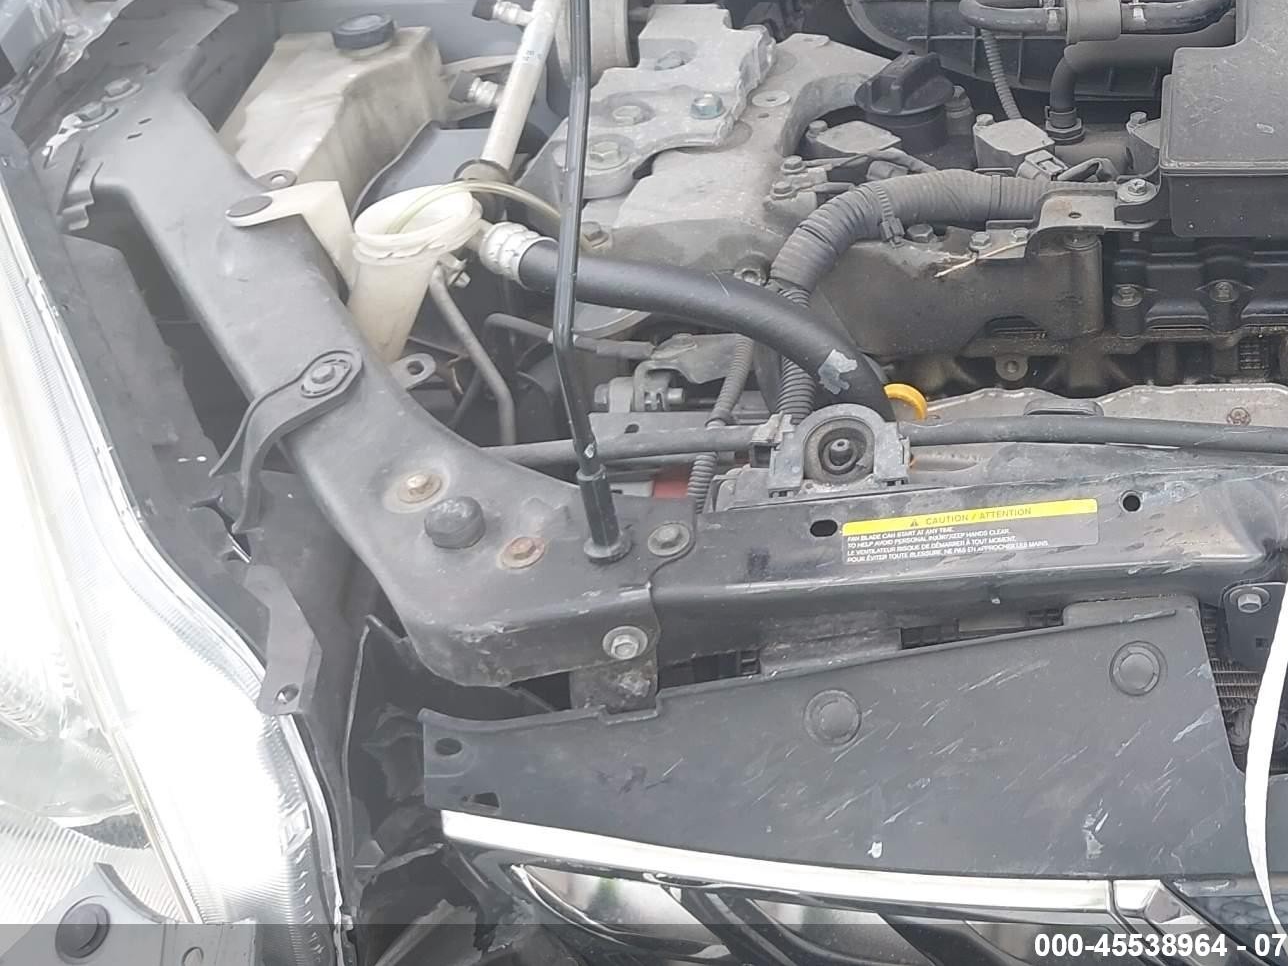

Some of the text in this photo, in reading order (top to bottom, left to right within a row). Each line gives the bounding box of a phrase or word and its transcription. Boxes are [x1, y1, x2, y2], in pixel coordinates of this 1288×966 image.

[926, 515, 968, 525] CAUTION
[980, 508, 1032, 519] ATTENTION
[856, 547, 896, 555] VENTILATEUR
[971, 537, 987, 545] TOUT
[874, 539, 893, 547] AVOID
[894, 536, 927, 545] PERSONAL
[888, 552, 907, 560] TOUTE
